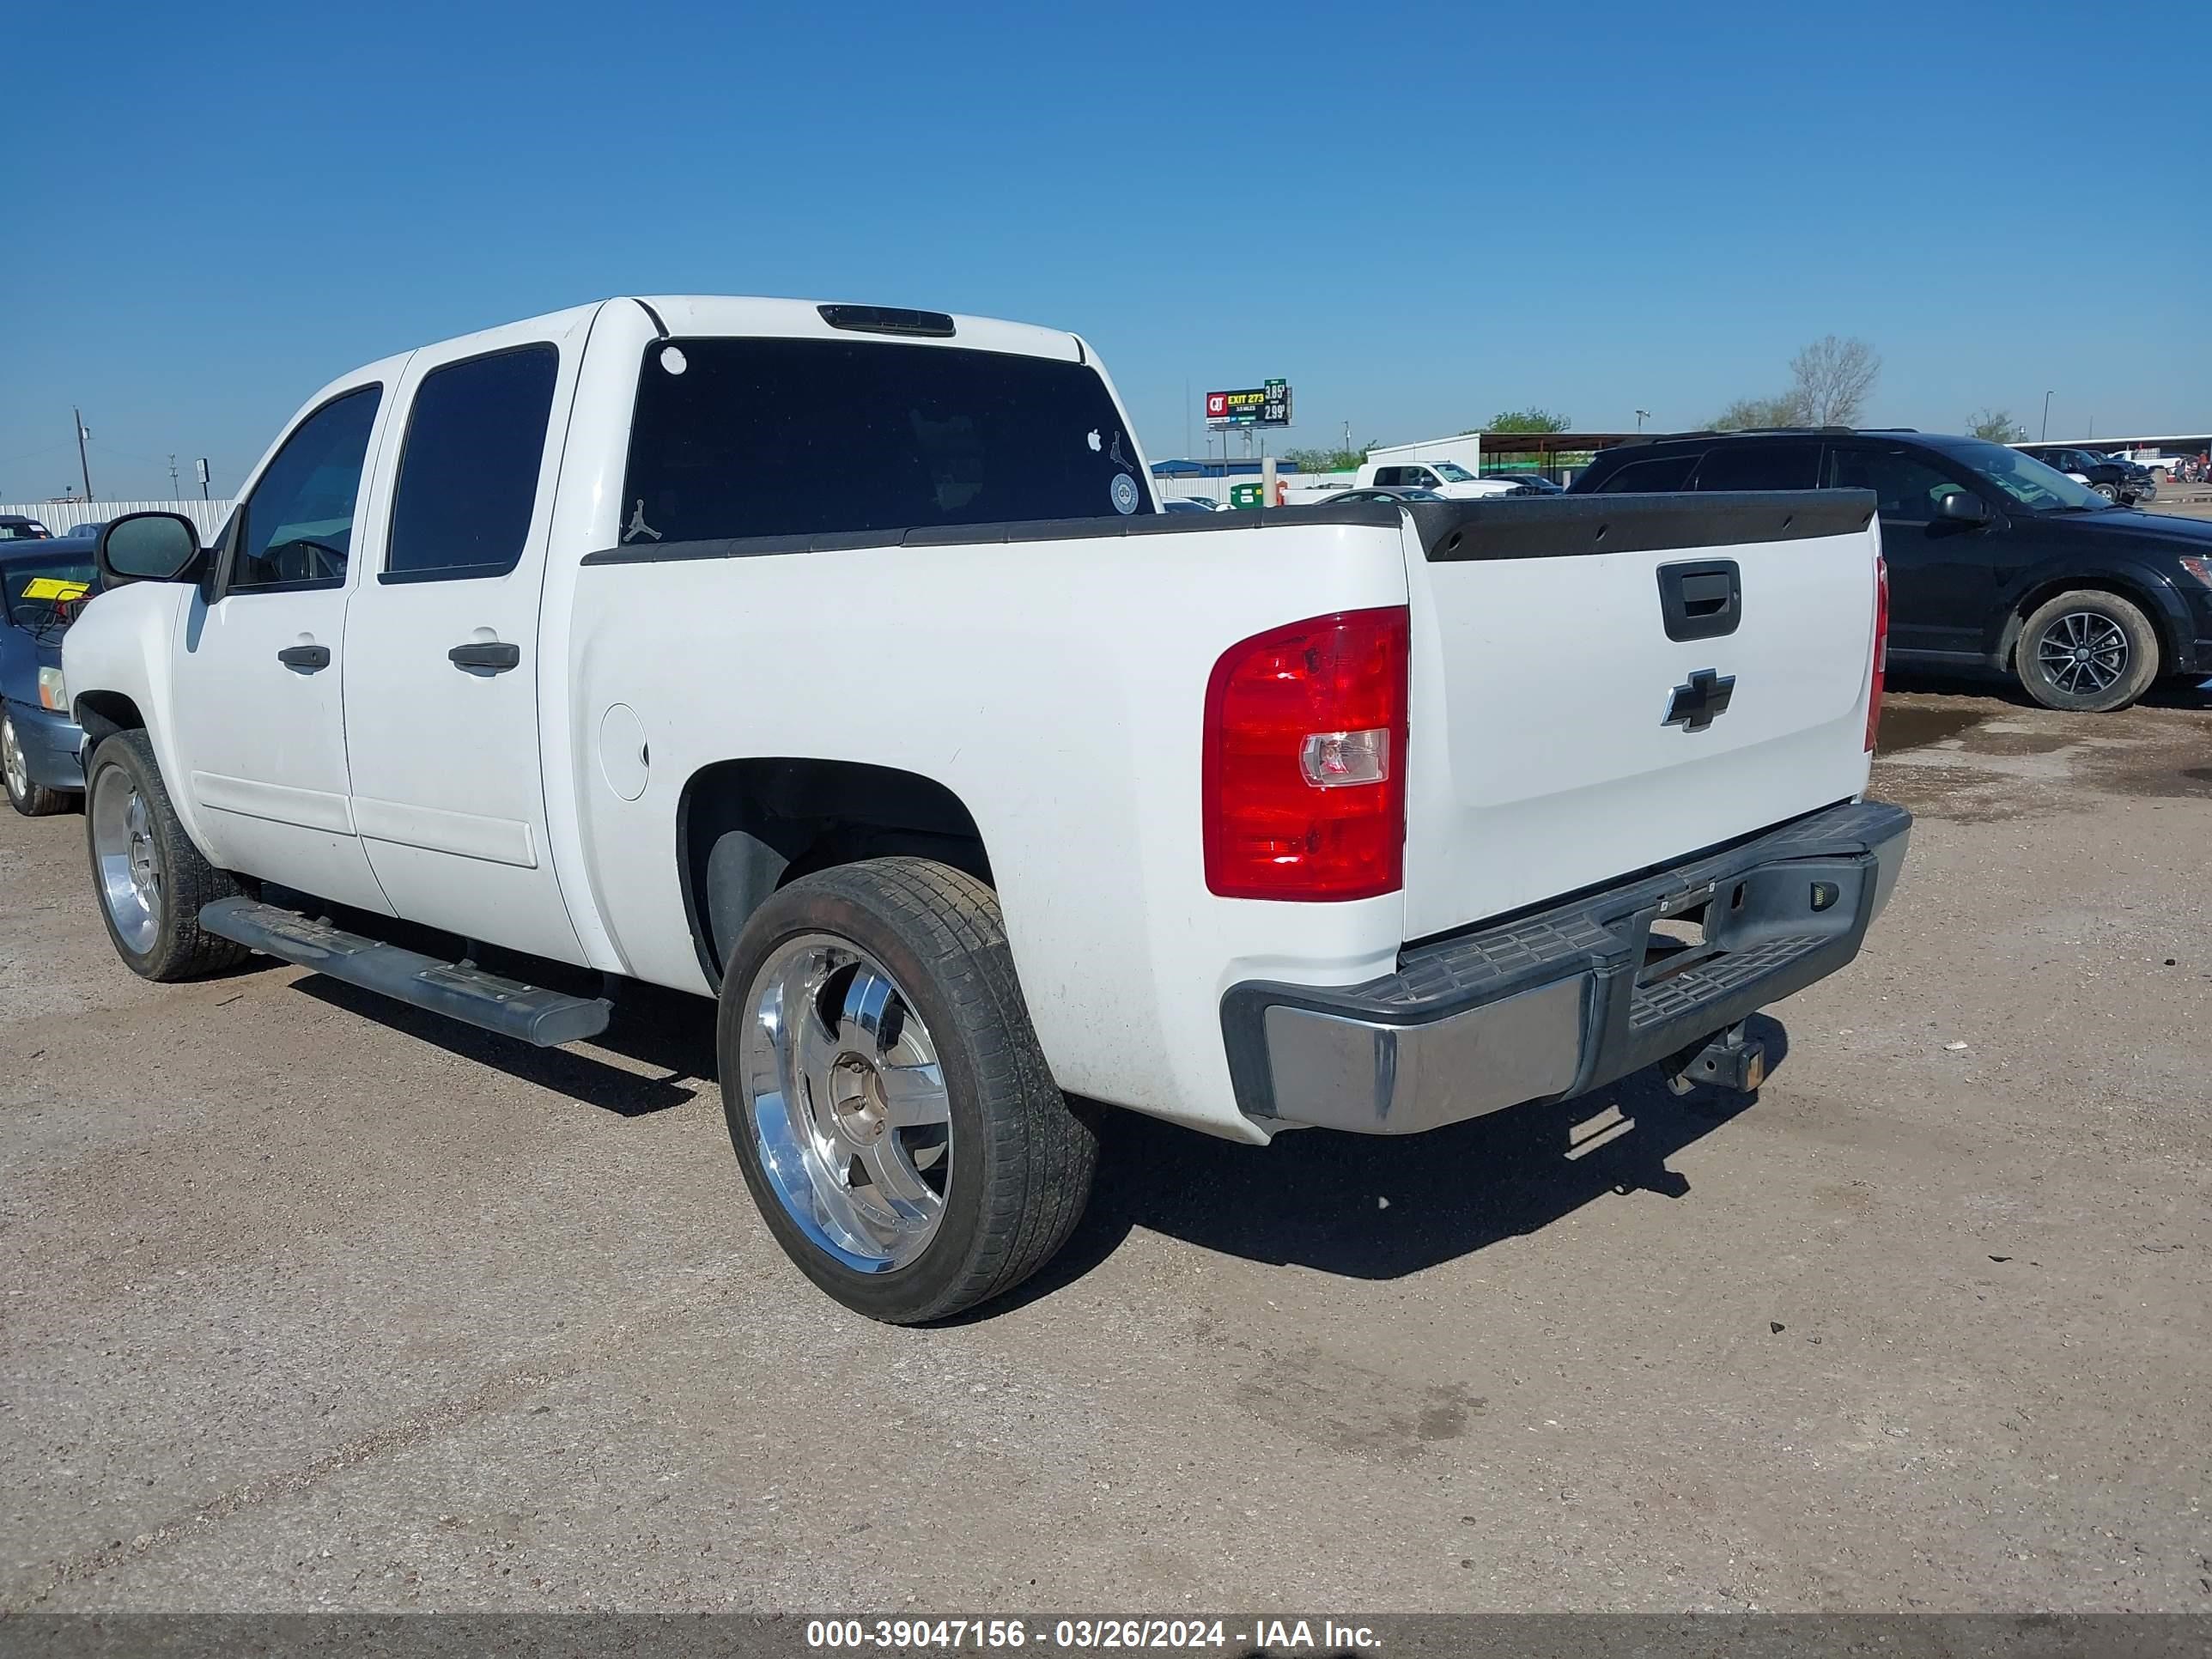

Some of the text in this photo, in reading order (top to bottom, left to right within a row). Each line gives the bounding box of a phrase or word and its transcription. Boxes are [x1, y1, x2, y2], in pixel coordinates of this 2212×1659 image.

[1209, 397, 1224, 412] QT
[1228, 395, 1247, 404] EXIT
[1248, 393, 1264, 404] 273
